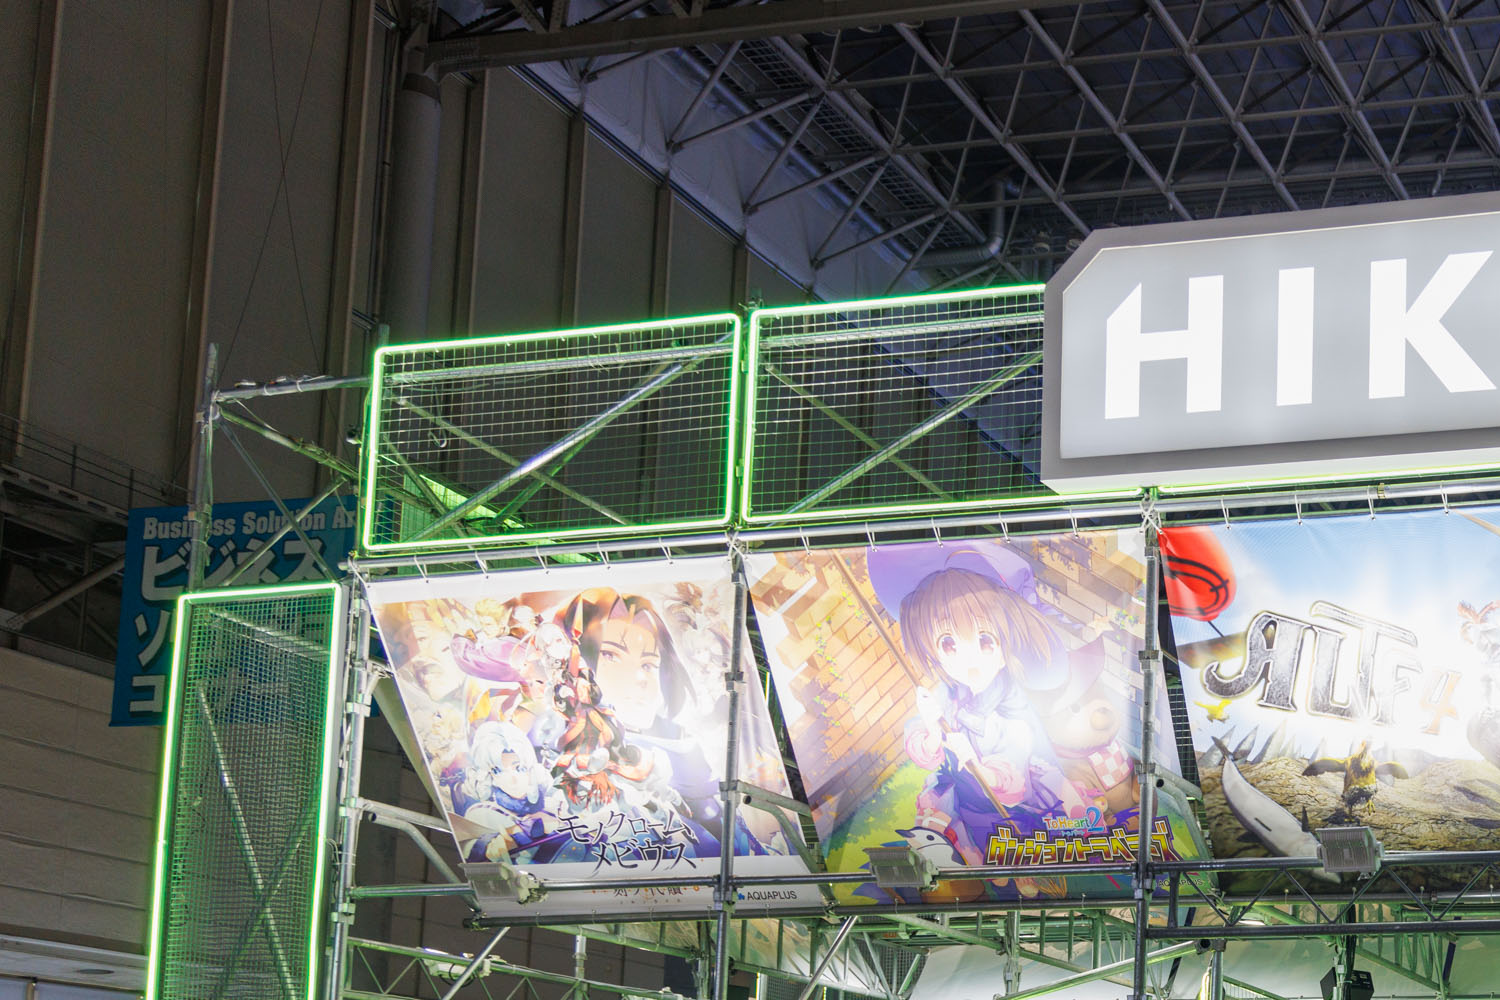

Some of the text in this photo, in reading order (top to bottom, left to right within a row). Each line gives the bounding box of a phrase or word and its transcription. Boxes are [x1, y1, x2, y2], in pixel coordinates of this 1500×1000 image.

[557, 810, 696, 844] モノクローム
[591, 840, 697, 877] メビウス
[747, 891, 797, 900] AQUAPLUS
